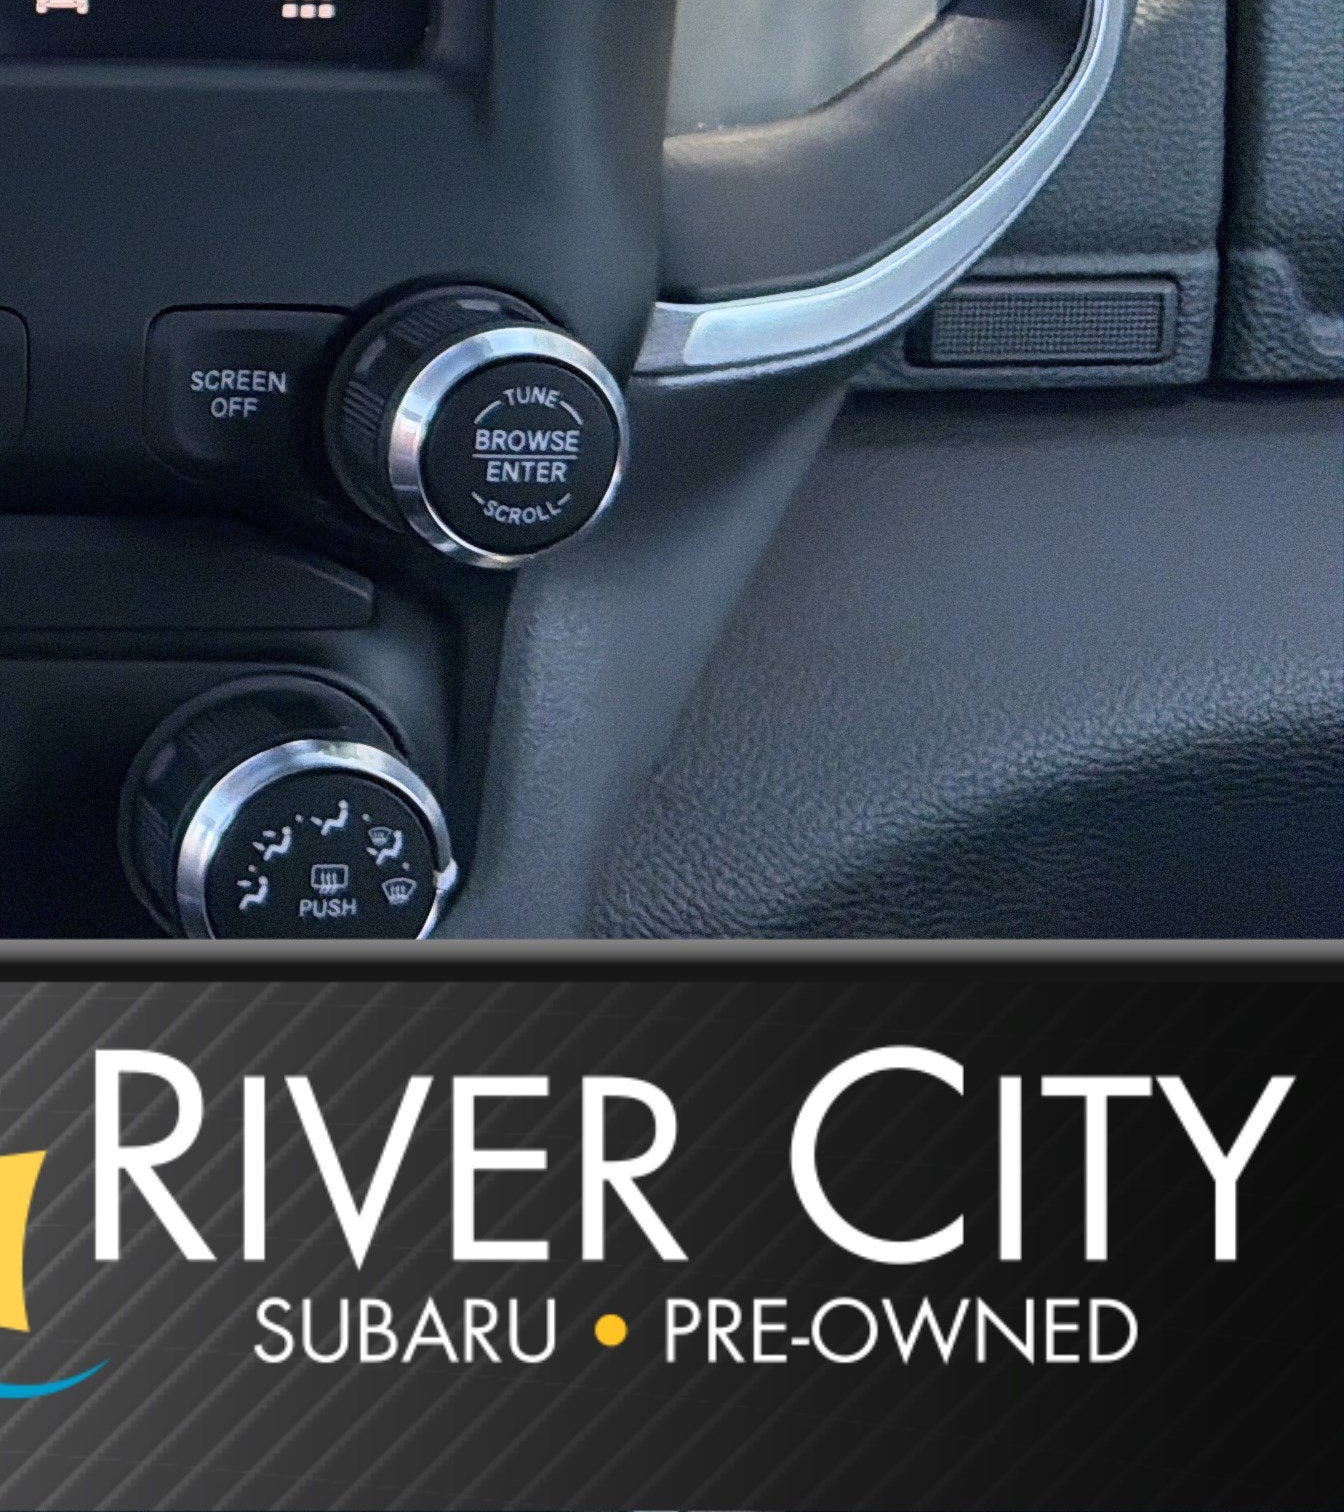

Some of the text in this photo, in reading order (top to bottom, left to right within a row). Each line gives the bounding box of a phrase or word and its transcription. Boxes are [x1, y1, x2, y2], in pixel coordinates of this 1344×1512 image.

[190, 369, 287, 394] SCREEN
[210, 397, 258, 419] OFF
[502, 386, 562, 410] TUNE
[474, 429, 581, 453] BROWSE
[485, 460, 567, 484] ENTER
[482, 498, 563, 526] SCROLL
[299, 899, 357, 917] PUSH
